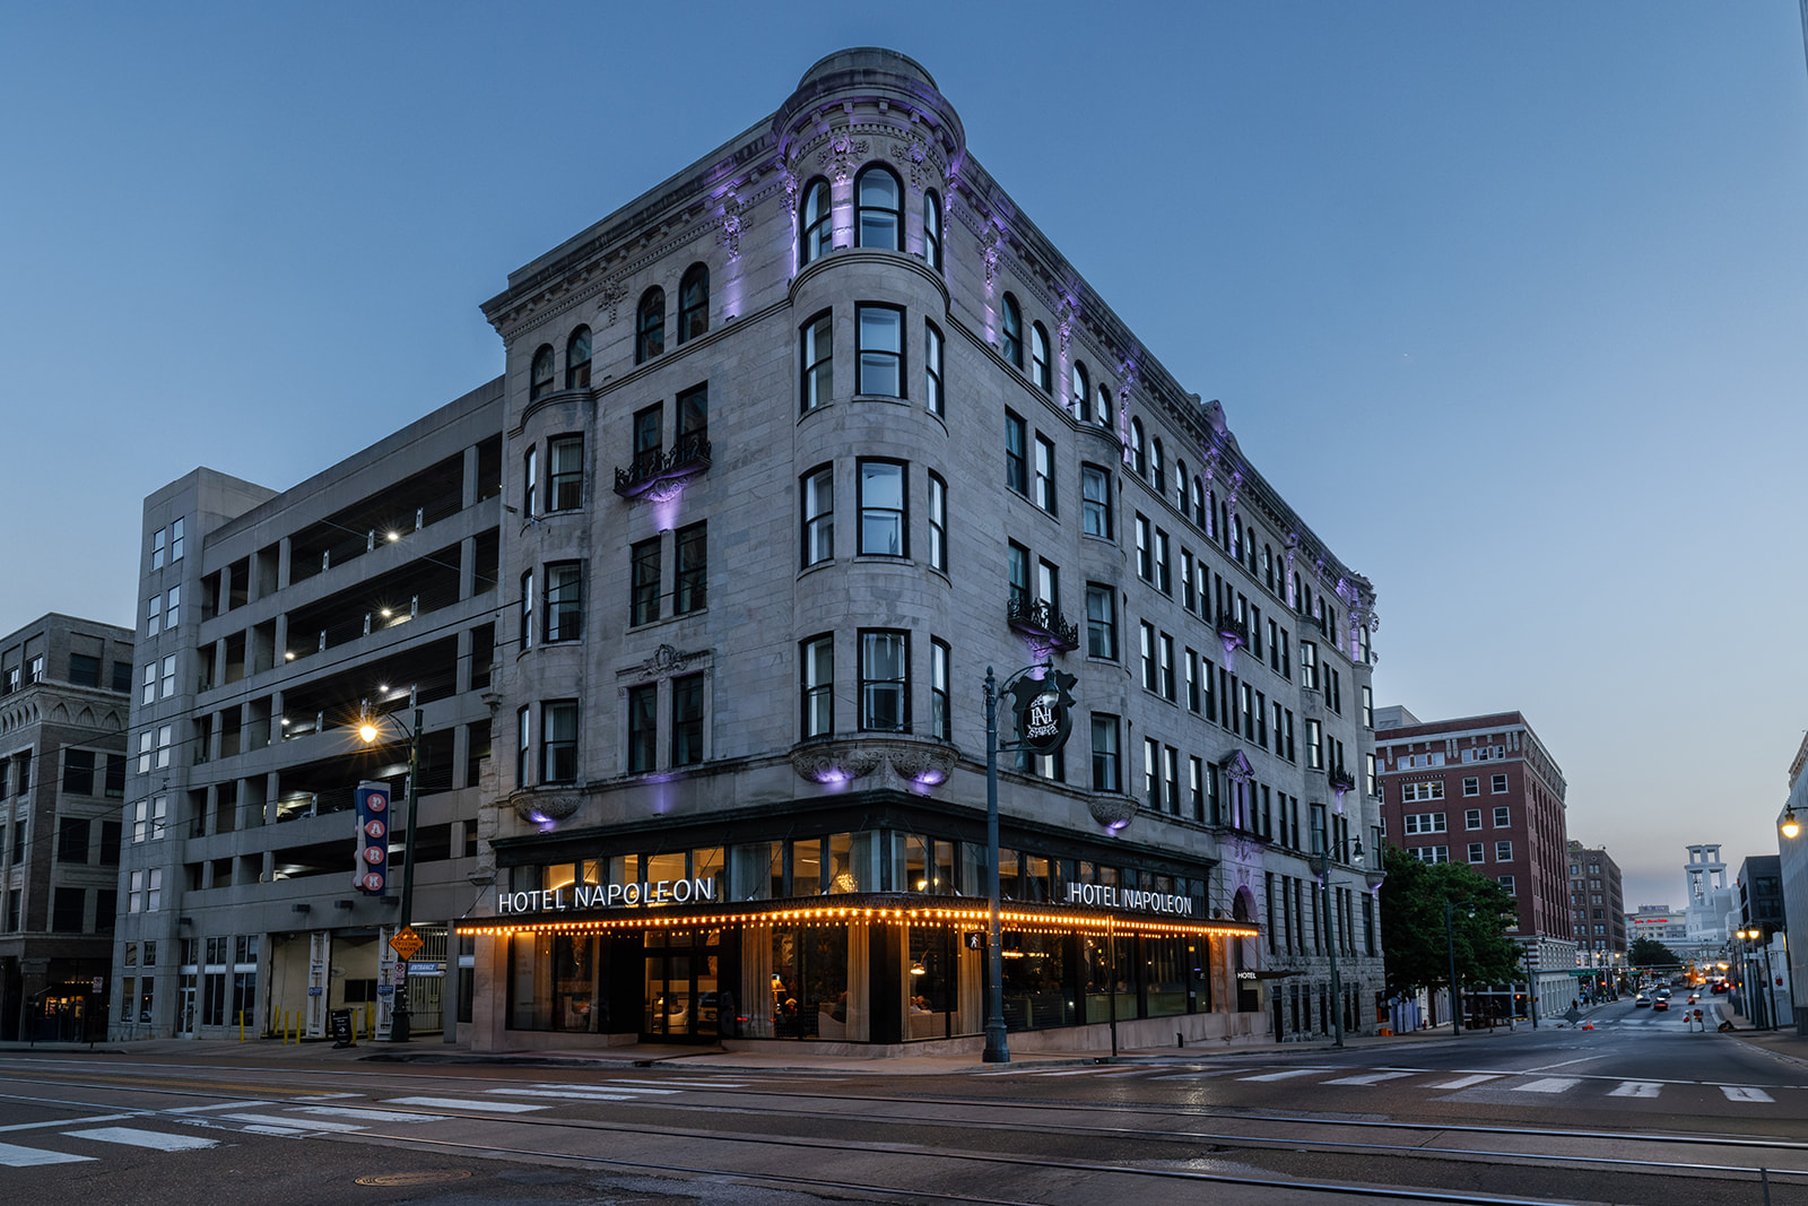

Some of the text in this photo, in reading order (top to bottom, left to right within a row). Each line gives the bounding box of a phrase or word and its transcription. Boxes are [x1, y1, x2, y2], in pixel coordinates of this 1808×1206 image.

[369, 796, 382, 887] PARK
[499, 877, 713, 913] HOTEL NAPOLEON
[1070, 882, 1192, 915] HOTEL NAPOLEON
[1237, 971, 1257, 979] HOTEL
